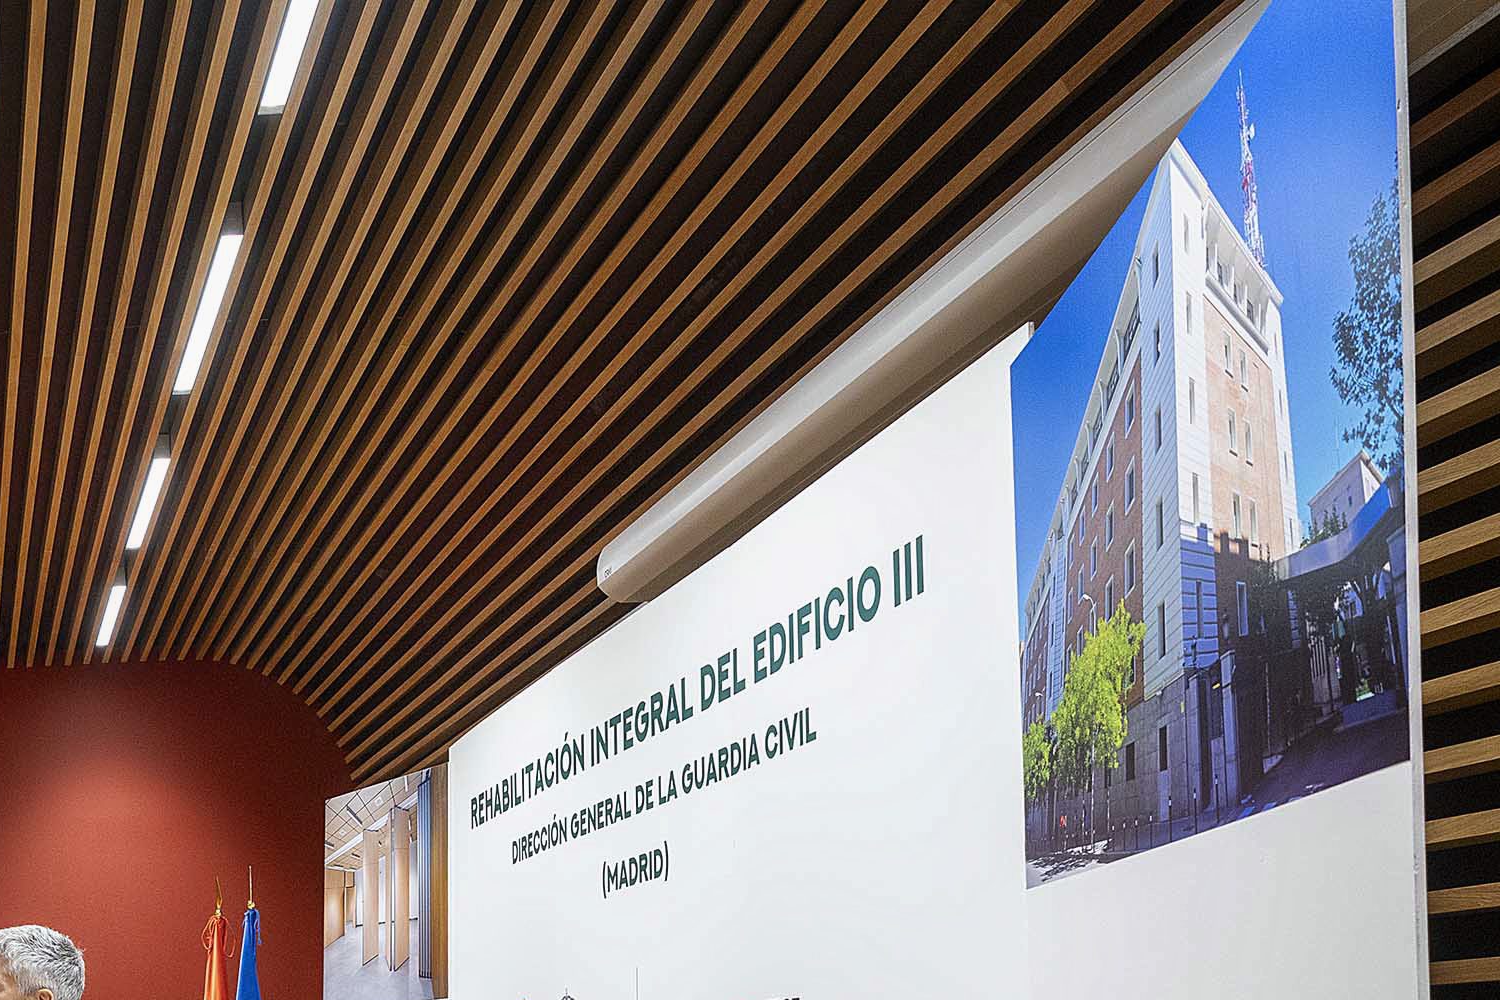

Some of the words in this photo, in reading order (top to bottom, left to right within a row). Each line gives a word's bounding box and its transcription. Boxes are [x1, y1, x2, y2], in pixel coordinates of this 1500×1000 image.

[470, 731, 585, 830] REHABILITACIÓN
[590, 677, 694, 768] INTEGRAL
[700, 647, 746, 712] DEL
[753, 565, 882, 684] EDIFICIO
[892, 534, 925, 608] III
[511, 813, 568, 865] DIRECCIÓN
[570, 792, 632, 840] GENERAL
[635, 778, 653, 816] DE
[658, 769, 678, 806] LA
[681, 732, 761, 794] GUARDIA
[764, 707, 817, 760] CIVIL
[601, 840, 669, 899] (MADRID)
